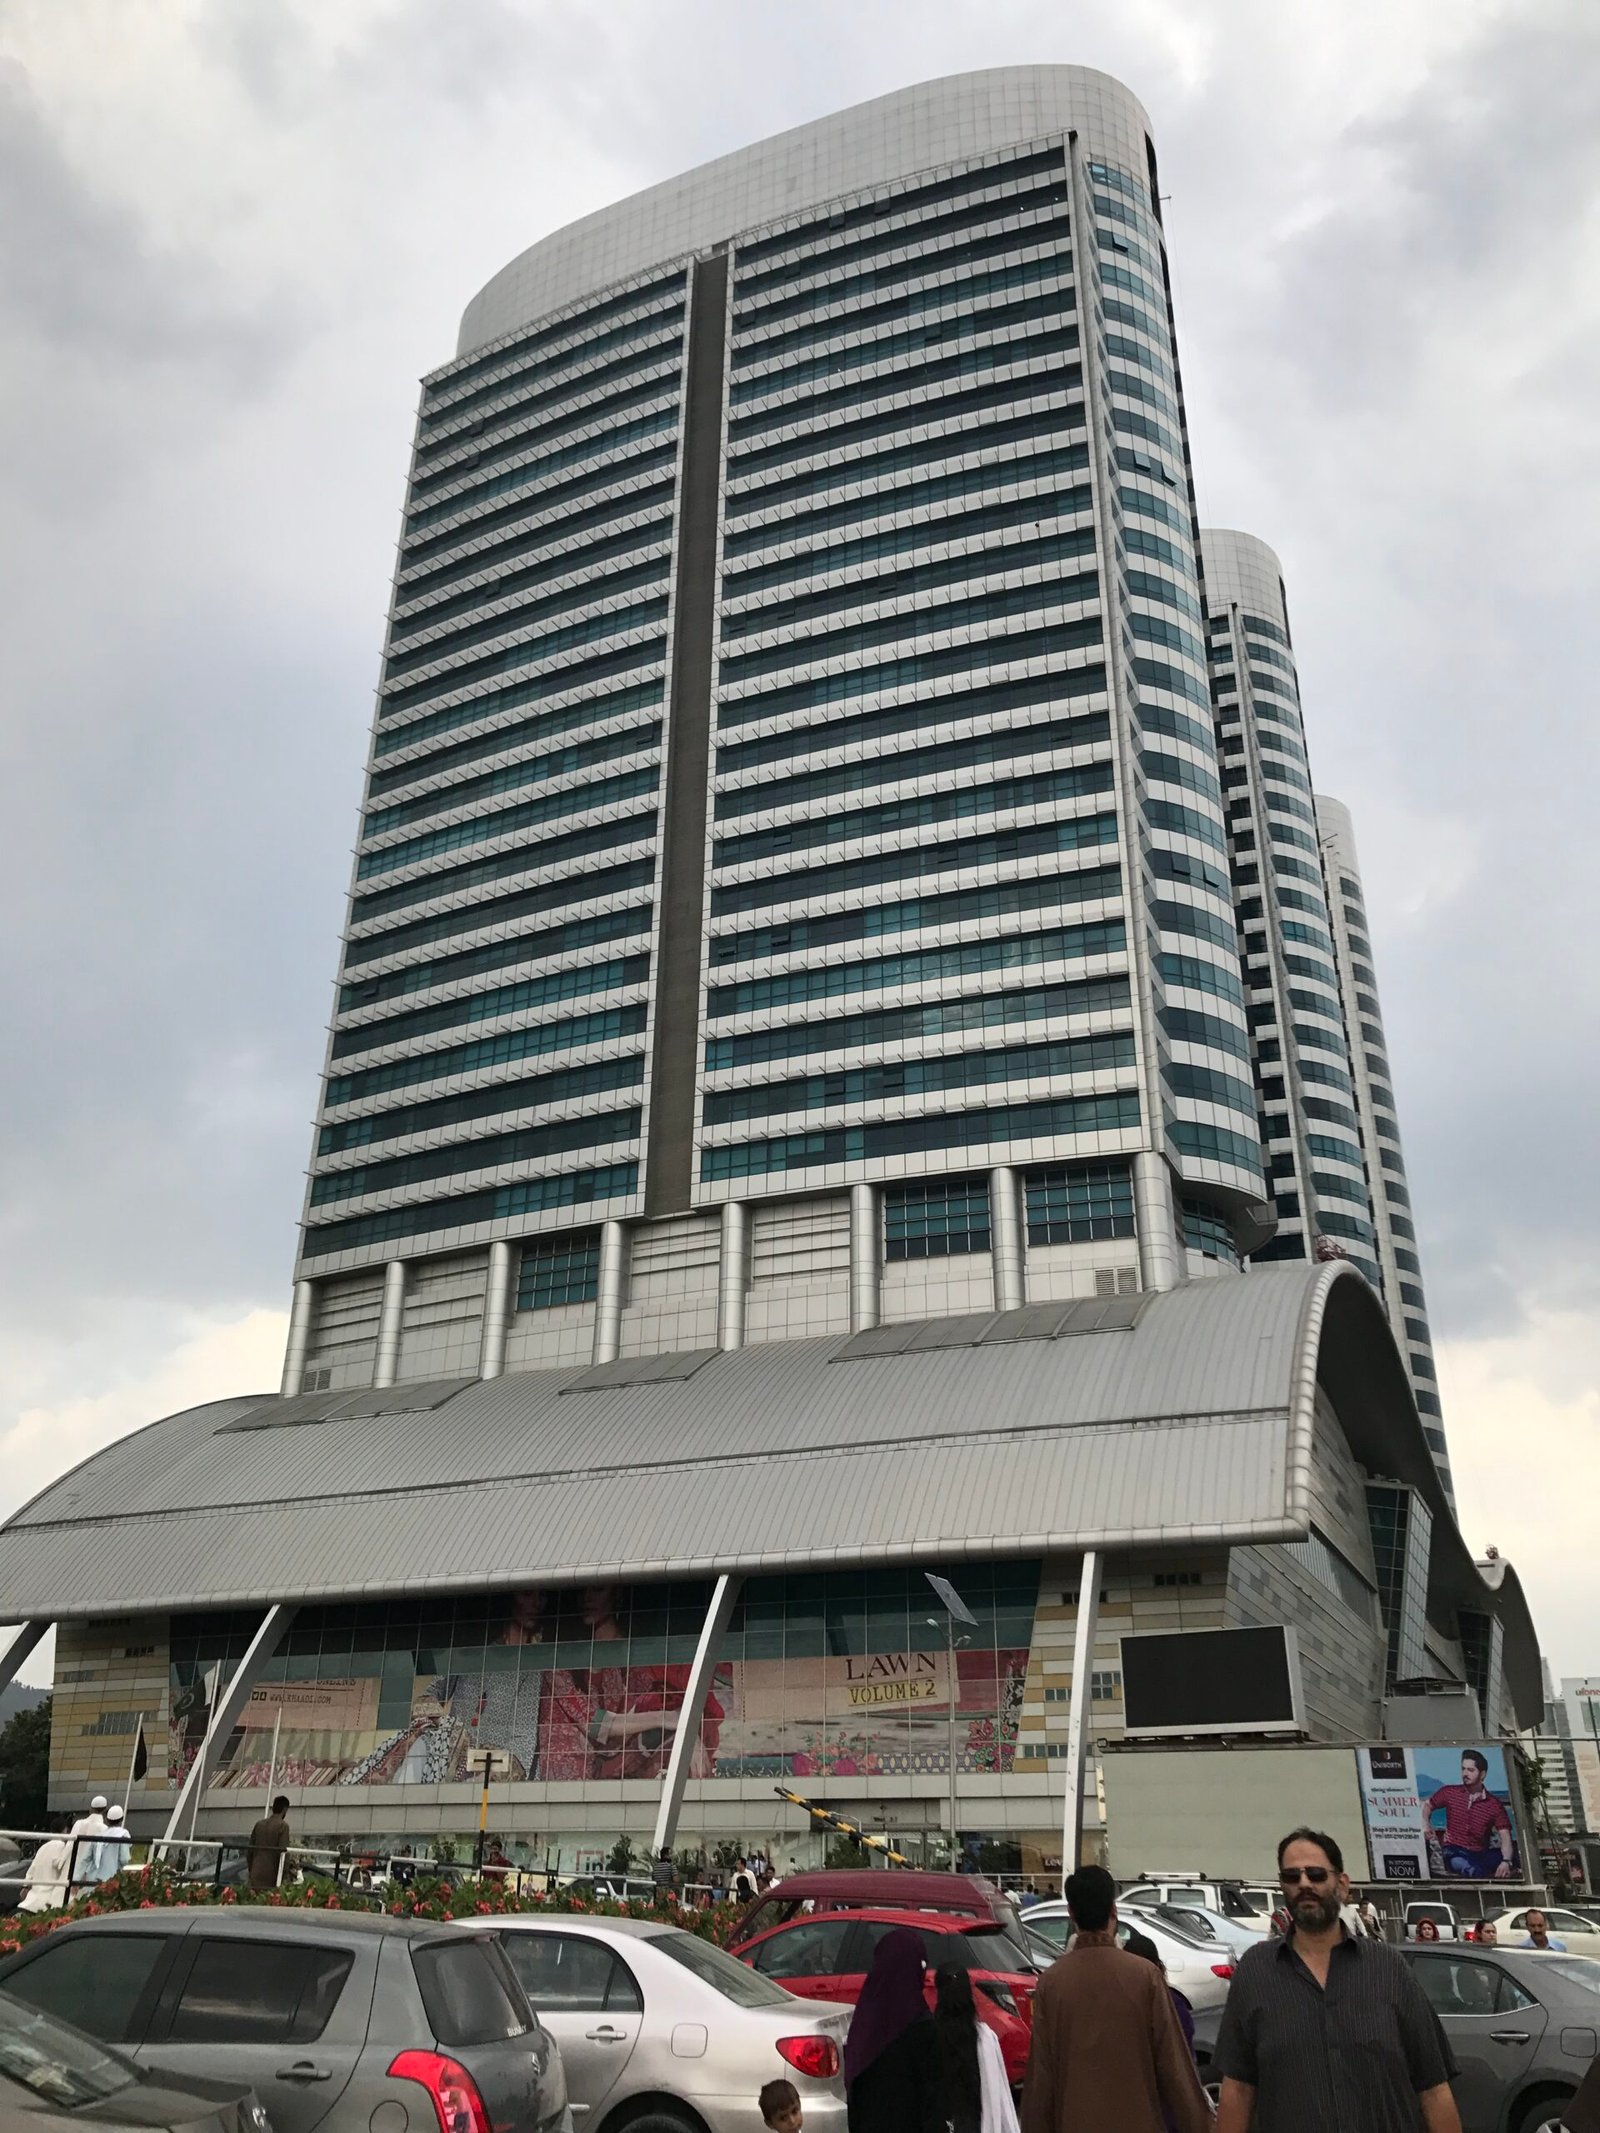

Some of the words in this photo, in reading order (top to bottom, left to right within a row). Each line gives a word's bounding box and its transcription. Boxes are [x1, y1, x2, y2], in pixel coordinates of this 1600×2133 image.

[846, 1653, 936, 1680] LAWN
[849, 1683, 919, 1703] VOLUME
[925, 1679, 935, 1696] 2
[1367, 1797, 1418, 1807] SUMMER
[1378, 1808, 1411, 1818] SOUL
[1388, 1866, 1415, 1876] NOW
[507, 2024, 527, 2037] BUNNY
